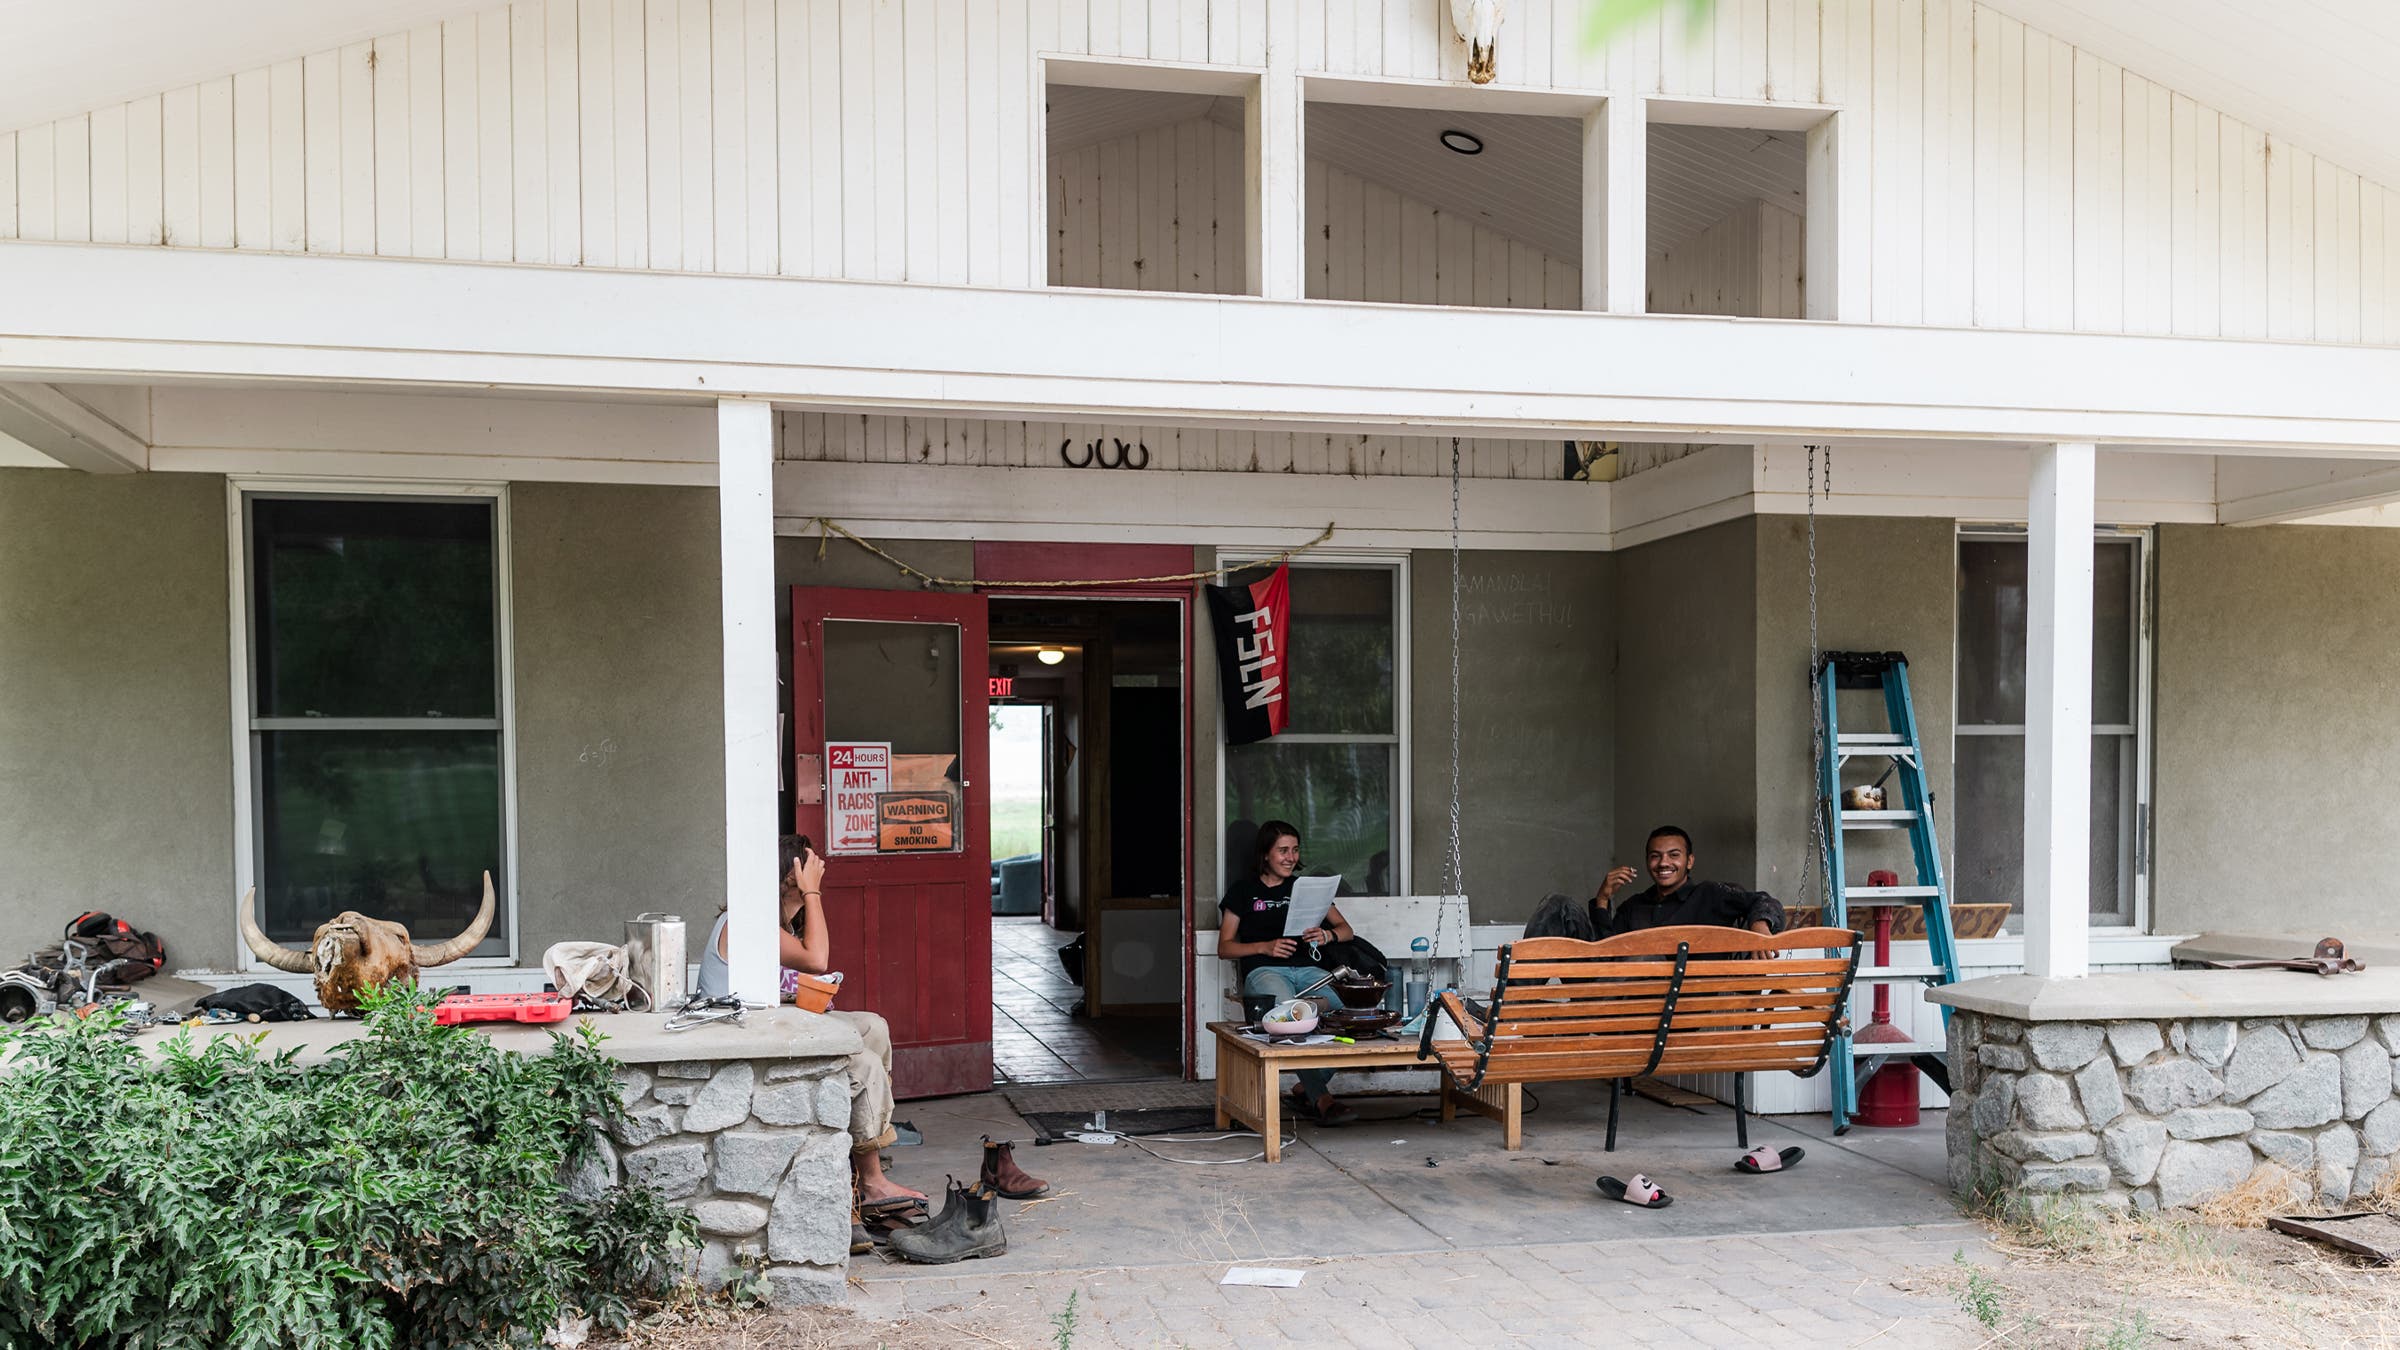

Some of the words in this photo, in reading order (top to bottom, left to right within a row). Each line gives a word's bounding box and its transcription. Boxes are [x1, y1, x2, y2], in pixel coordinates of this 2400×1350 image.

[1234, 606, 1282, 710] FSLN
[989, 678, 1012, 696] EXIT
[833, 751, 852, 765] 24
[855, 753, 885, 762] HOURS
[843, 771, 878, 789] ANTI-
[838, 793, 877, 811] RACIS
[887, 804, 945, 816] WARNING
[845, 814, 875, 832] ZONE
[909, 826, 923, 835] NO
[894, 836, 938, 846] SMOKING
